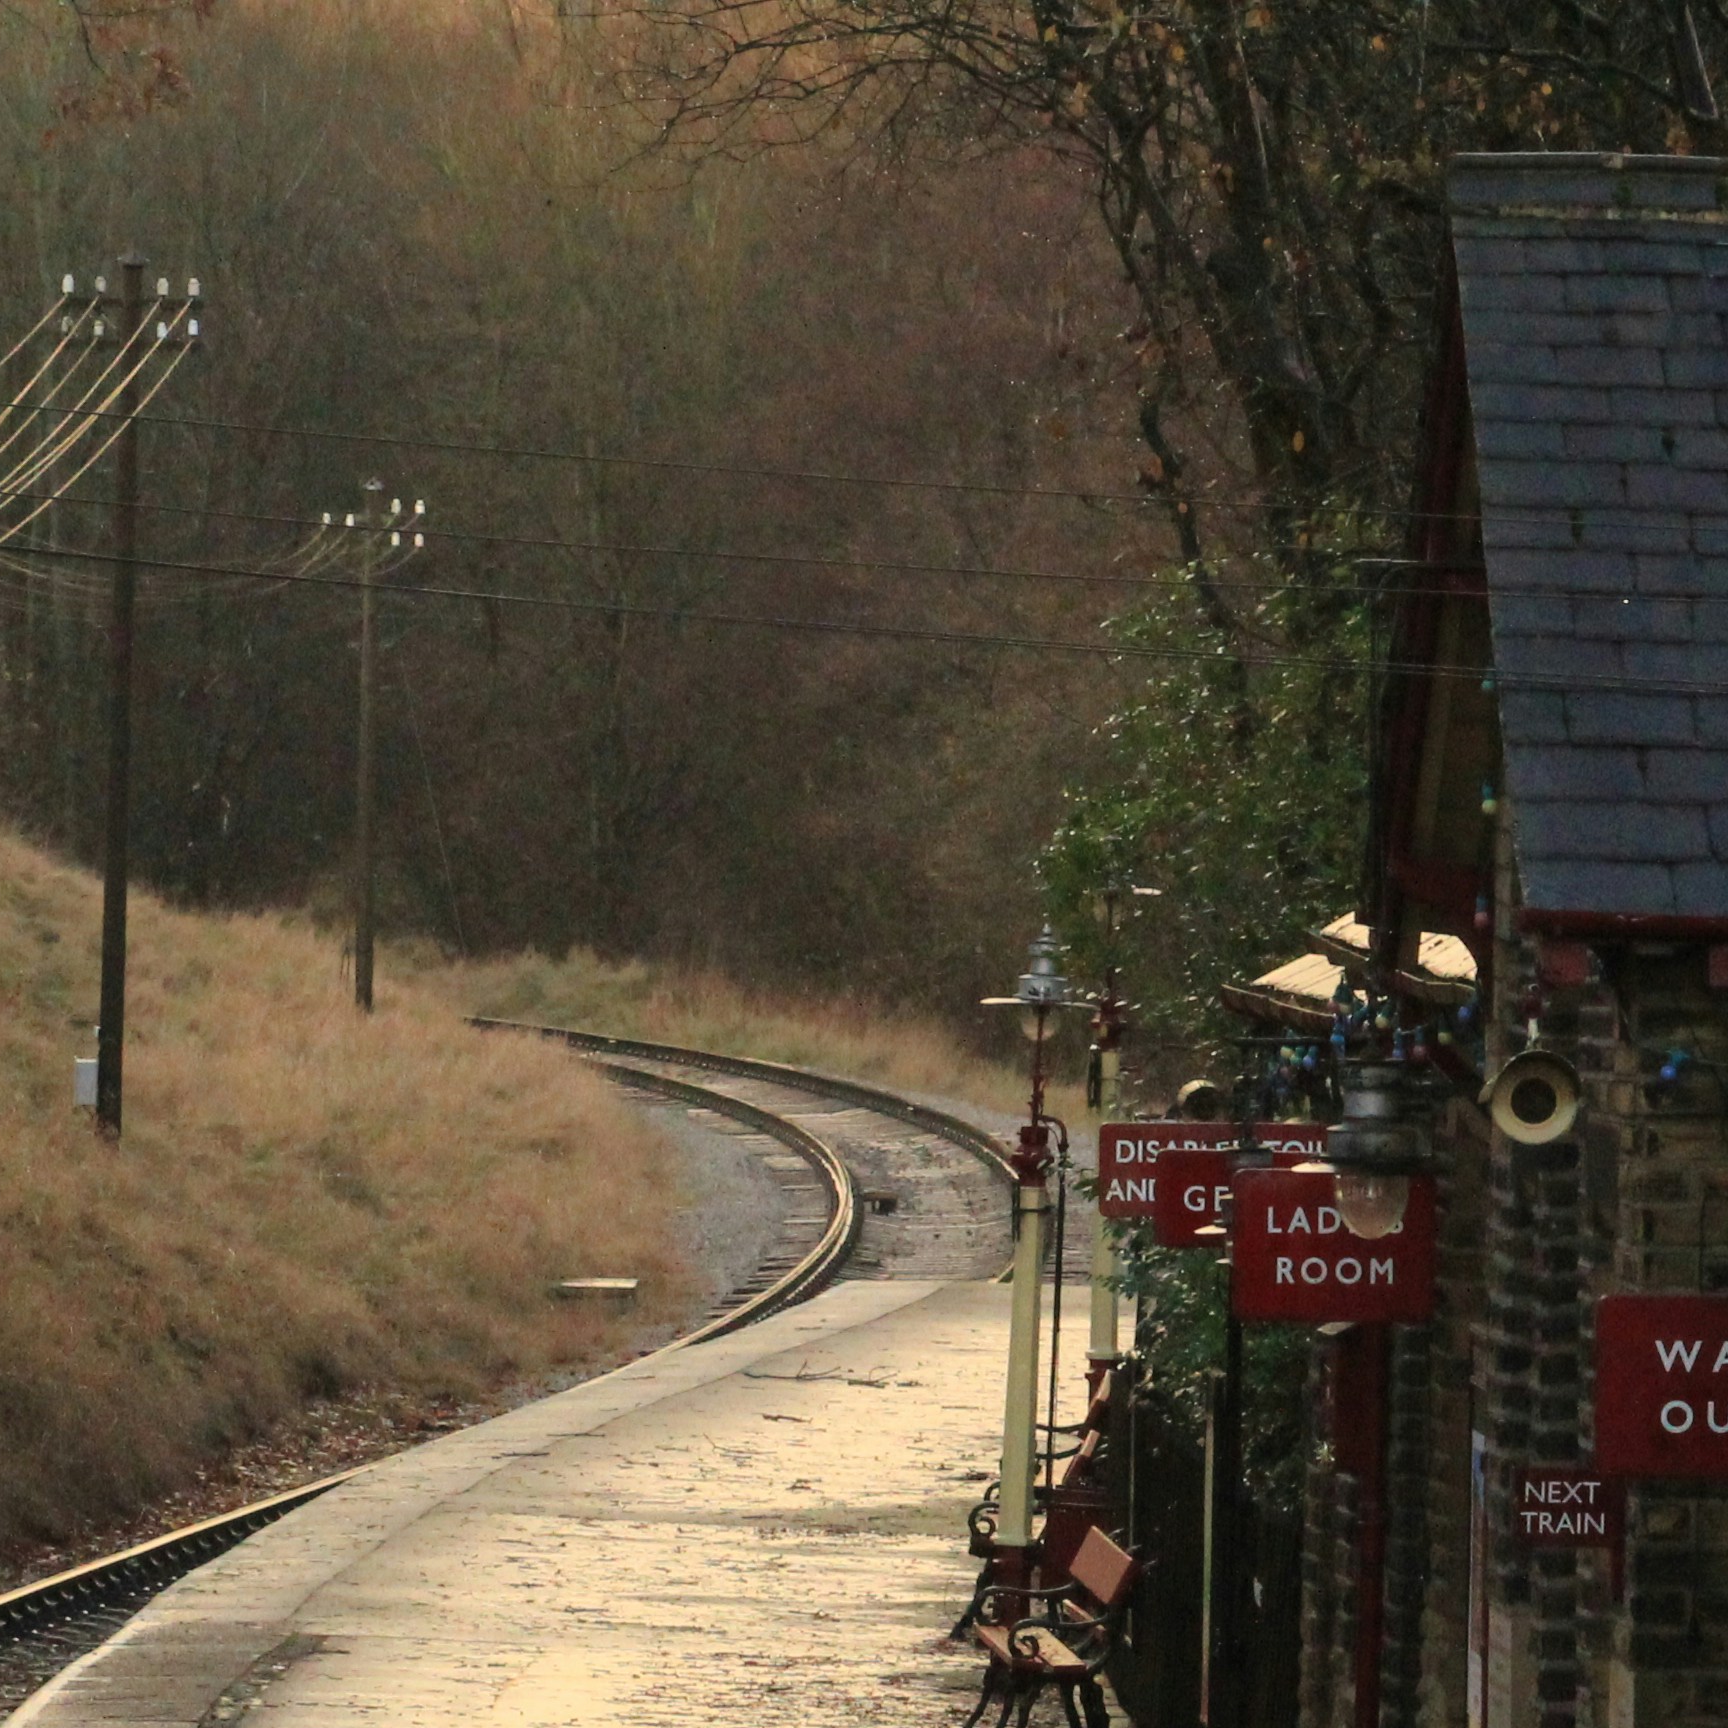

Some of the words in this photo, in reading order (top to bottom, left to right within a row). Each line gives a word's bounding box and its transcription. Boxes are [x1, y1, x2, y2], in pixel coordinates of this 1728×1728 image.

[1266, 1205, 1404, 1235] LAD
[1275, 1256, 1395, 1285] ROOM
[1524, 1481, 1601, 1504] NEXT
[1520, 1511, 1606, 1535] TRAIN
